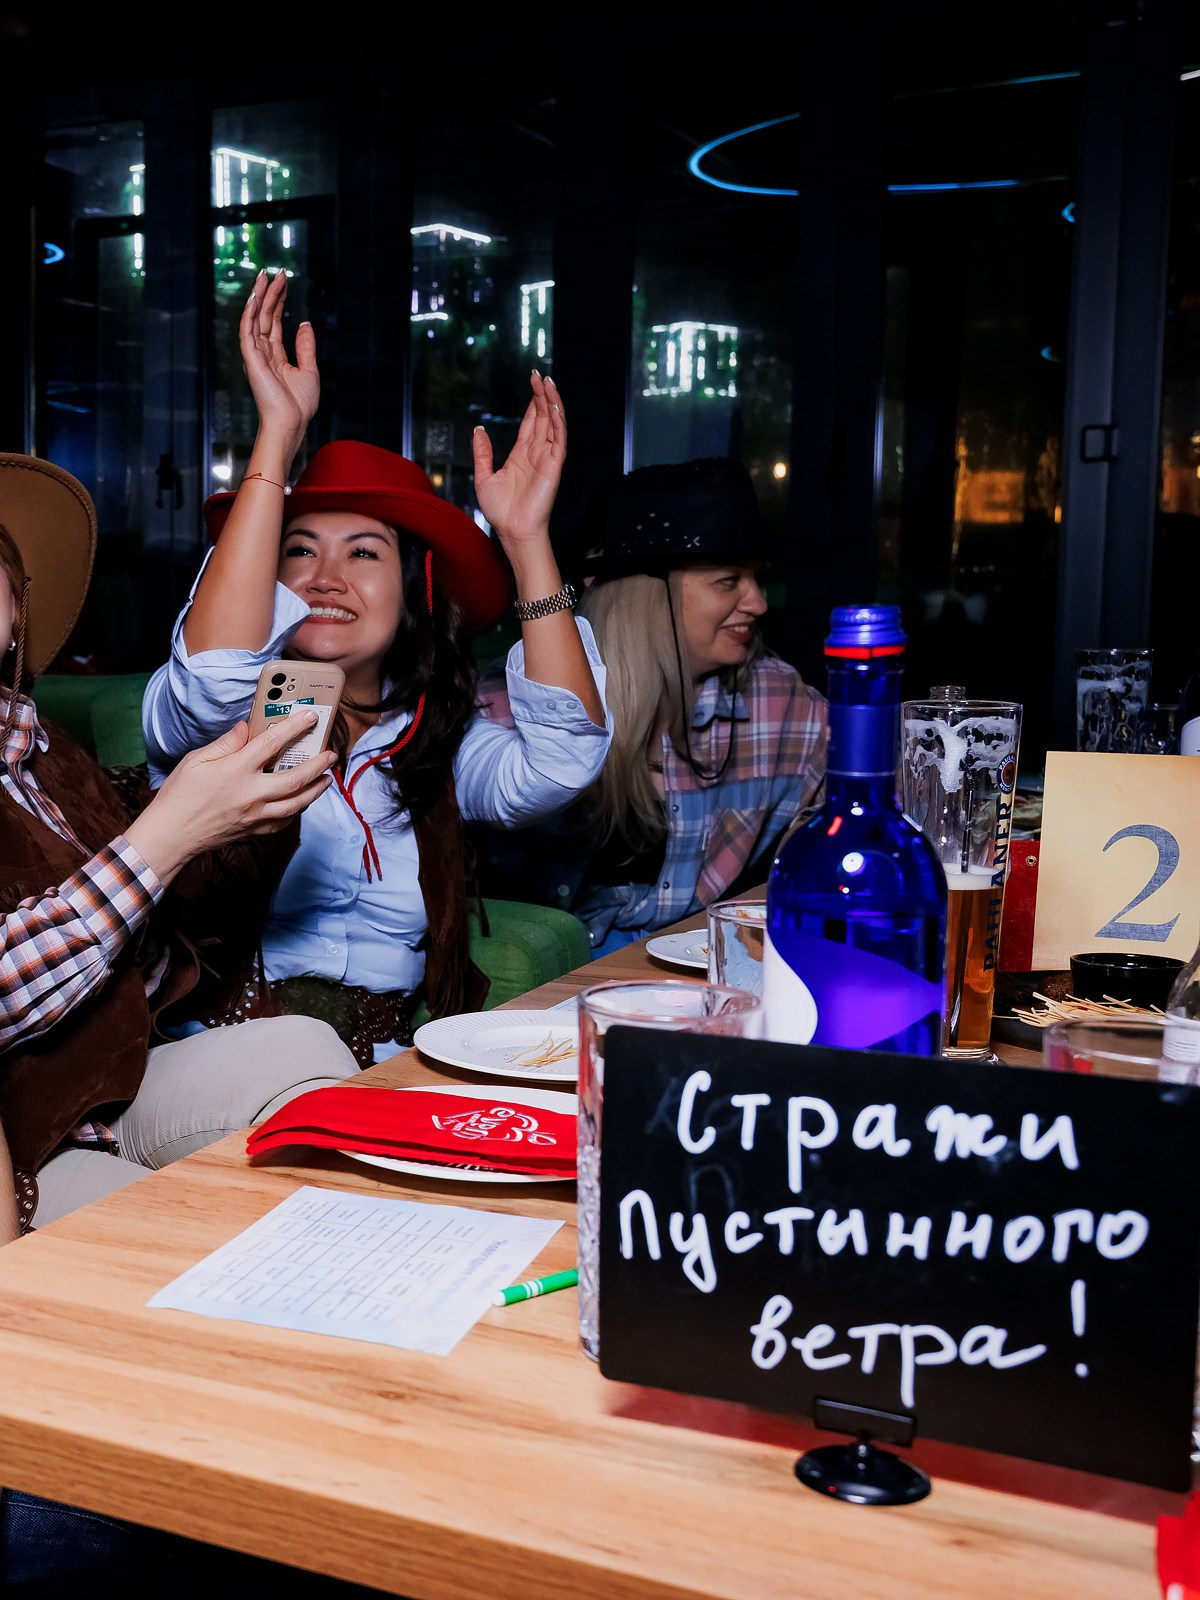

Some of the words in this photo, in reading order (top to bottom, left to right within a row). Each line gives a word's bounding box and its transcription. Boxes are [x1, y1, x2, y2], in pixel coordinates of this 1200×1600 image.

[1094, 824, 1181, 942] 2
[676, 1070, 1080, 1194] Стражи
[618, 1188, 1150, 1294] Пустынного
